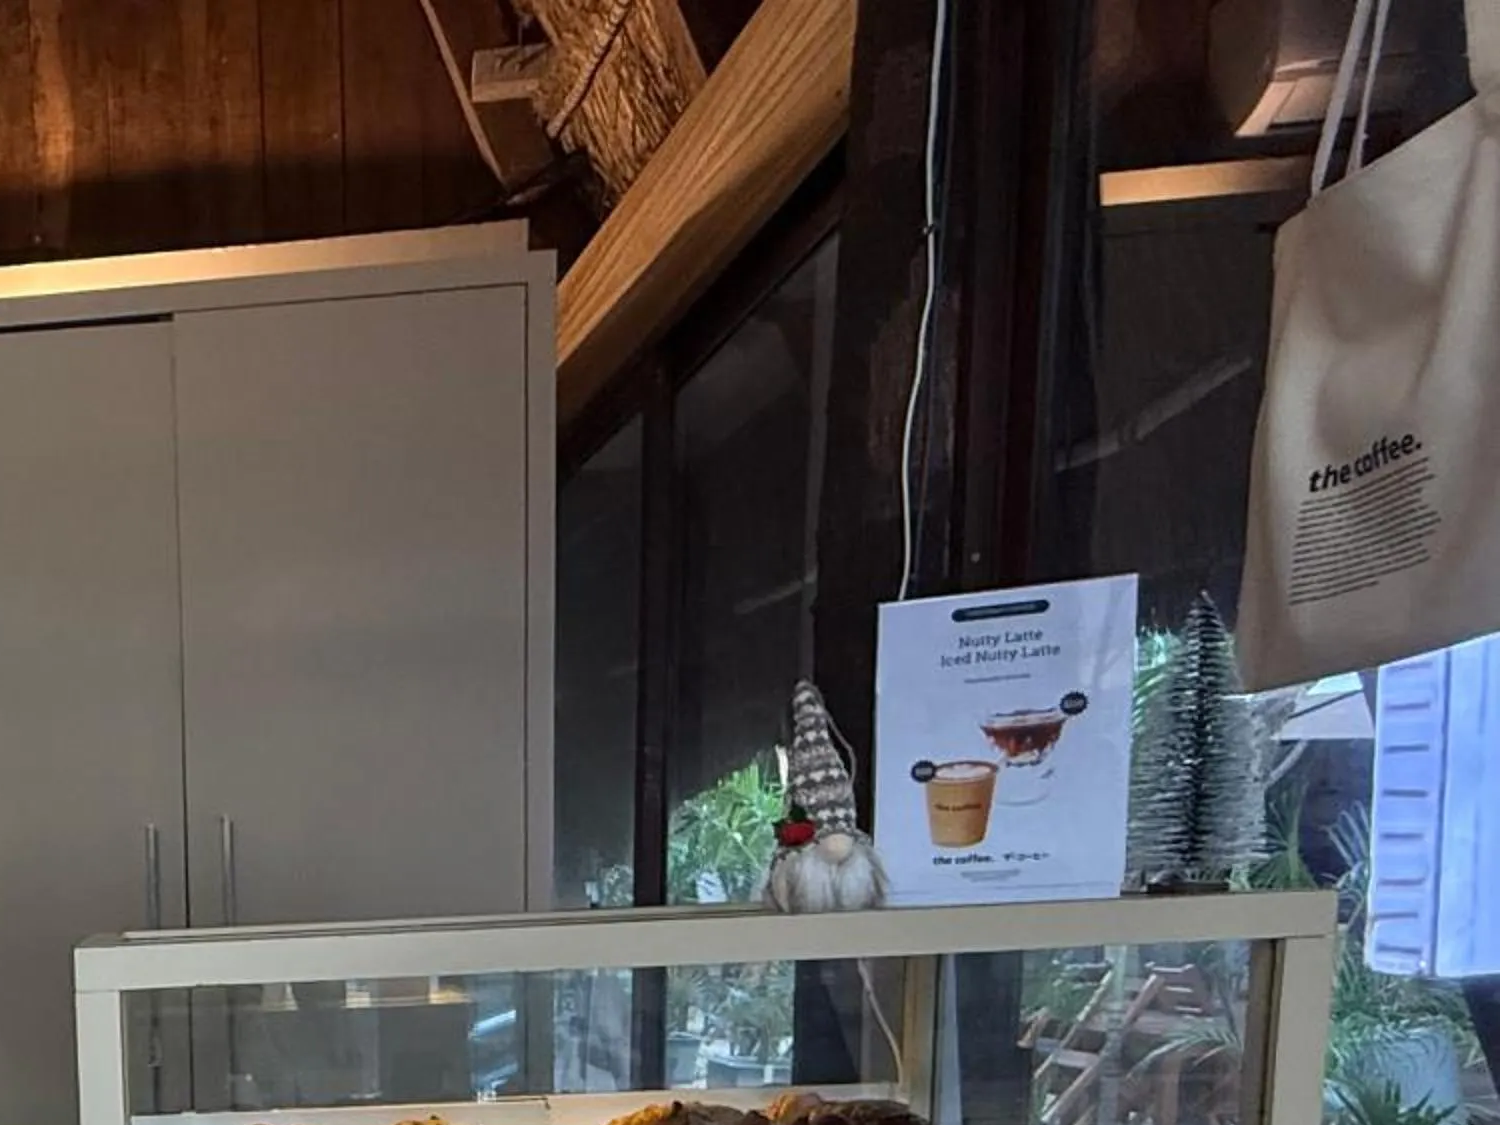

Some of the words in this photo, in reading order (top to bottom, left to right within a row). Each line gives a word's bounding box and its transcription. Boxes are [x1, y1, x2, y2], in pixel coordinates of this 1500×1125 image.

[1308, 463, 1351, 493] the
[1354, 433, 1422, 477] coffee.
[958, 635, 1000, 649] Nutty
[1004, 630, 1043, 643] Latte
[940, 652, 972, 668] Iced
[975, 649, 1018, 664] Nutty
[1020, 644, 1061, 659] Latte
